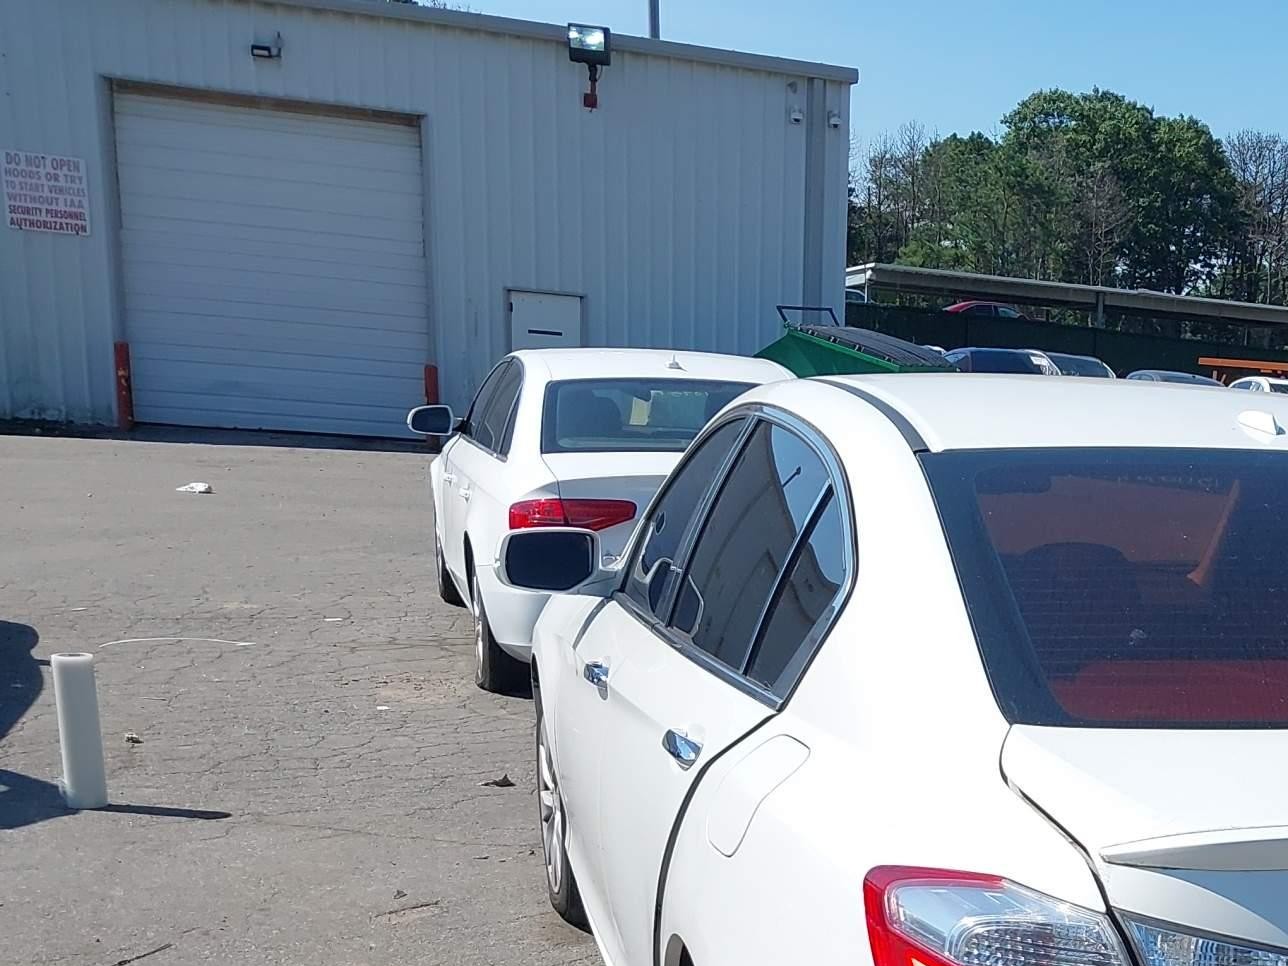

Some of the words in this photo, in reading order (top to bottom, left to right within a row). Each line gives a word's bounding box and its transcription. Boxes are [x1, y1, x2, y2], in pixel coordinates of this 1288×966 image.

[5, 151, 21, 166] DO
[25, 154, 46, 170] NOT
[51, 158, 80, 173] OPEN
[4, 167, 41, 180] HOODS
[45, 172, 60, 183] OR
[63, 174, 83, 185] TRY
[5, 180, 16, 190] TO
[19, 181, 45, 193] START
[48, 185, 86, 197] VEHICLES
[7, 192, 60, 207] WITHOUT
[64, 198, 84, 208] IAA
[8, 204, 43, 217] SECURITY
[45, 208, 87, 222] PERSONNEL
[9, 216, 87, 233] AUTHORIZATION
